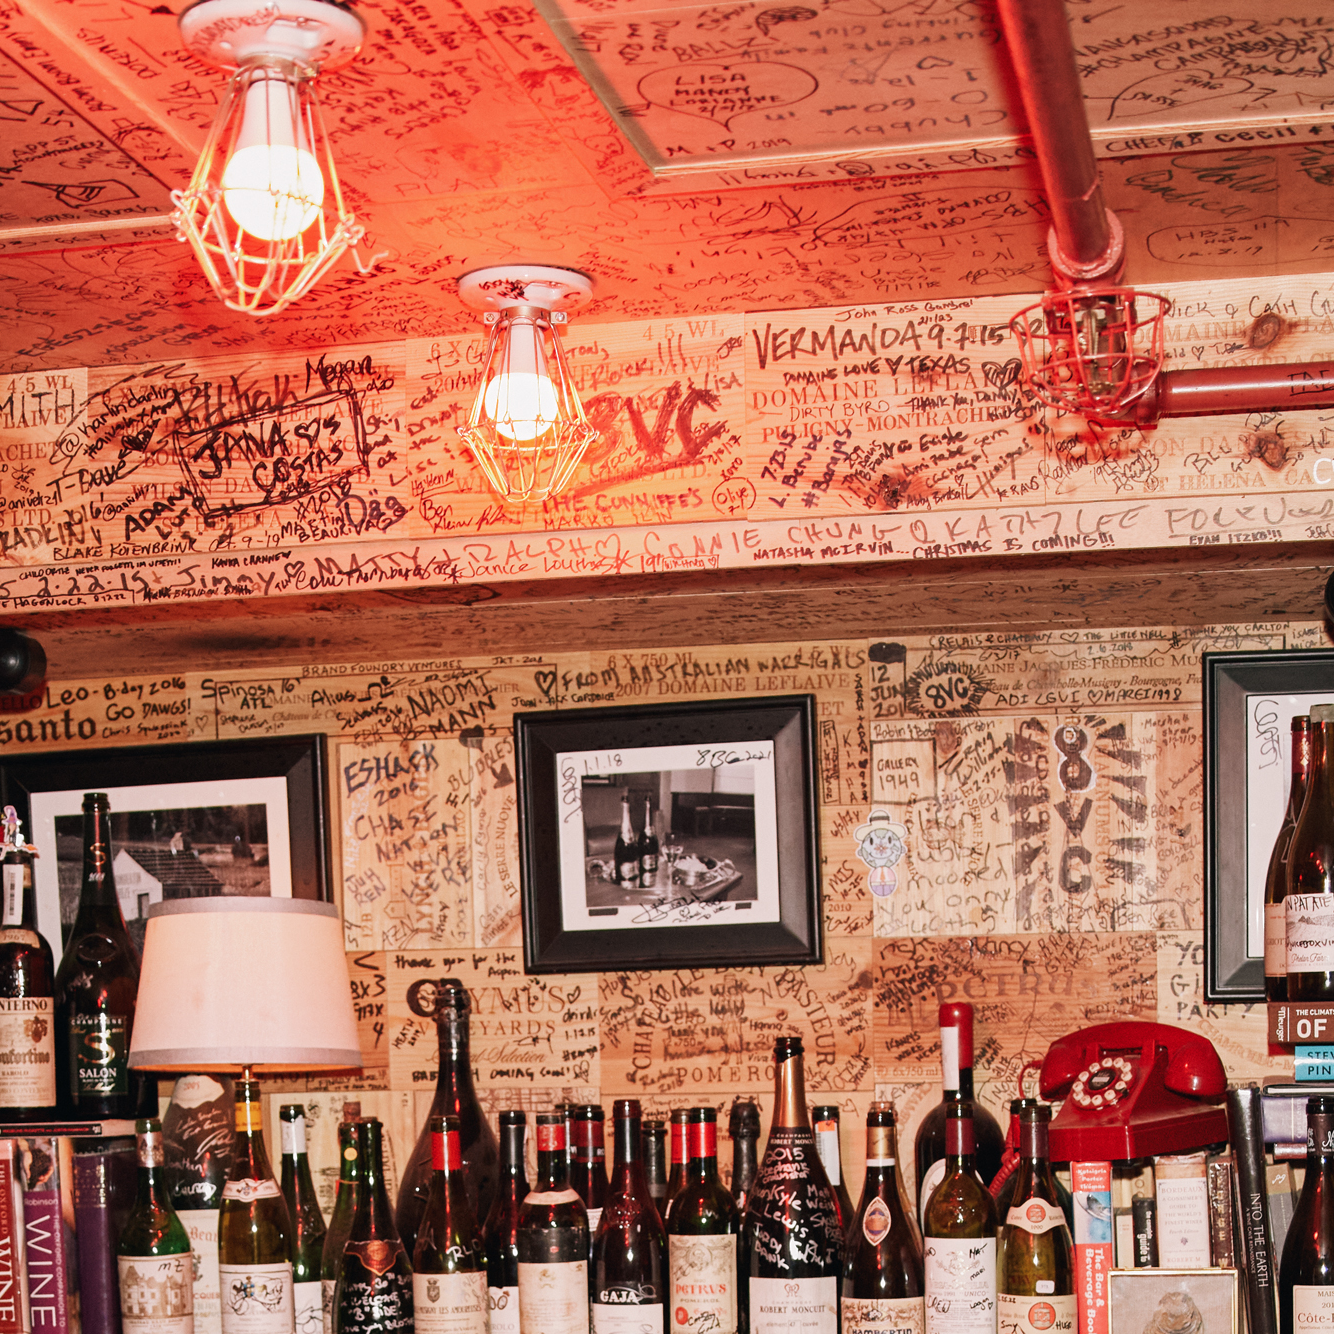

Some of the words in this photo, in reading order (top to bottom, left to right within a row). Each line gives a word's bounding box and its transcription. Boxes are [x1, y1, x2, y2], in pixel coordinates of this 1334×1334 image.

[753, 320, 921, 370] VERMANDA
[843, 359, 881, 376] LOVE
[905, 353, 971, 378] TEXAS
[752, 378, 879, 411] DOMAINE
[789, 403, 834, 422] DIRTY
[53, 545, 103, 562] BLAKE
[753, 546, 815, 562] NATASHA
[149, 677, 187, 695] 2016
[656, 675, 748, 695] DOMAINE
[877, 772, 920, 789] 1949
[1296, 1018, 1327, 1038] OF
[78, 1067, 117, 1079] SALON
[1250, 1192, 1262, 1221] INTO
[1254, 1224, 1266, 1248] THE
[1094, 1248, 1105, 1270] The
[1255, 1251, 1269, 1287] EARTH
[25, 1214, 57, 1327] WINE
[1085, 1248, 1095, 1305] Beverage
[1095, 1273, 1105, 1293] Bar
[600, 1290, 638, 1303] GAJA
[759, 1305, 788, 1314] ROBERT
[791, 1304, 826, 1314] MONCUIT
